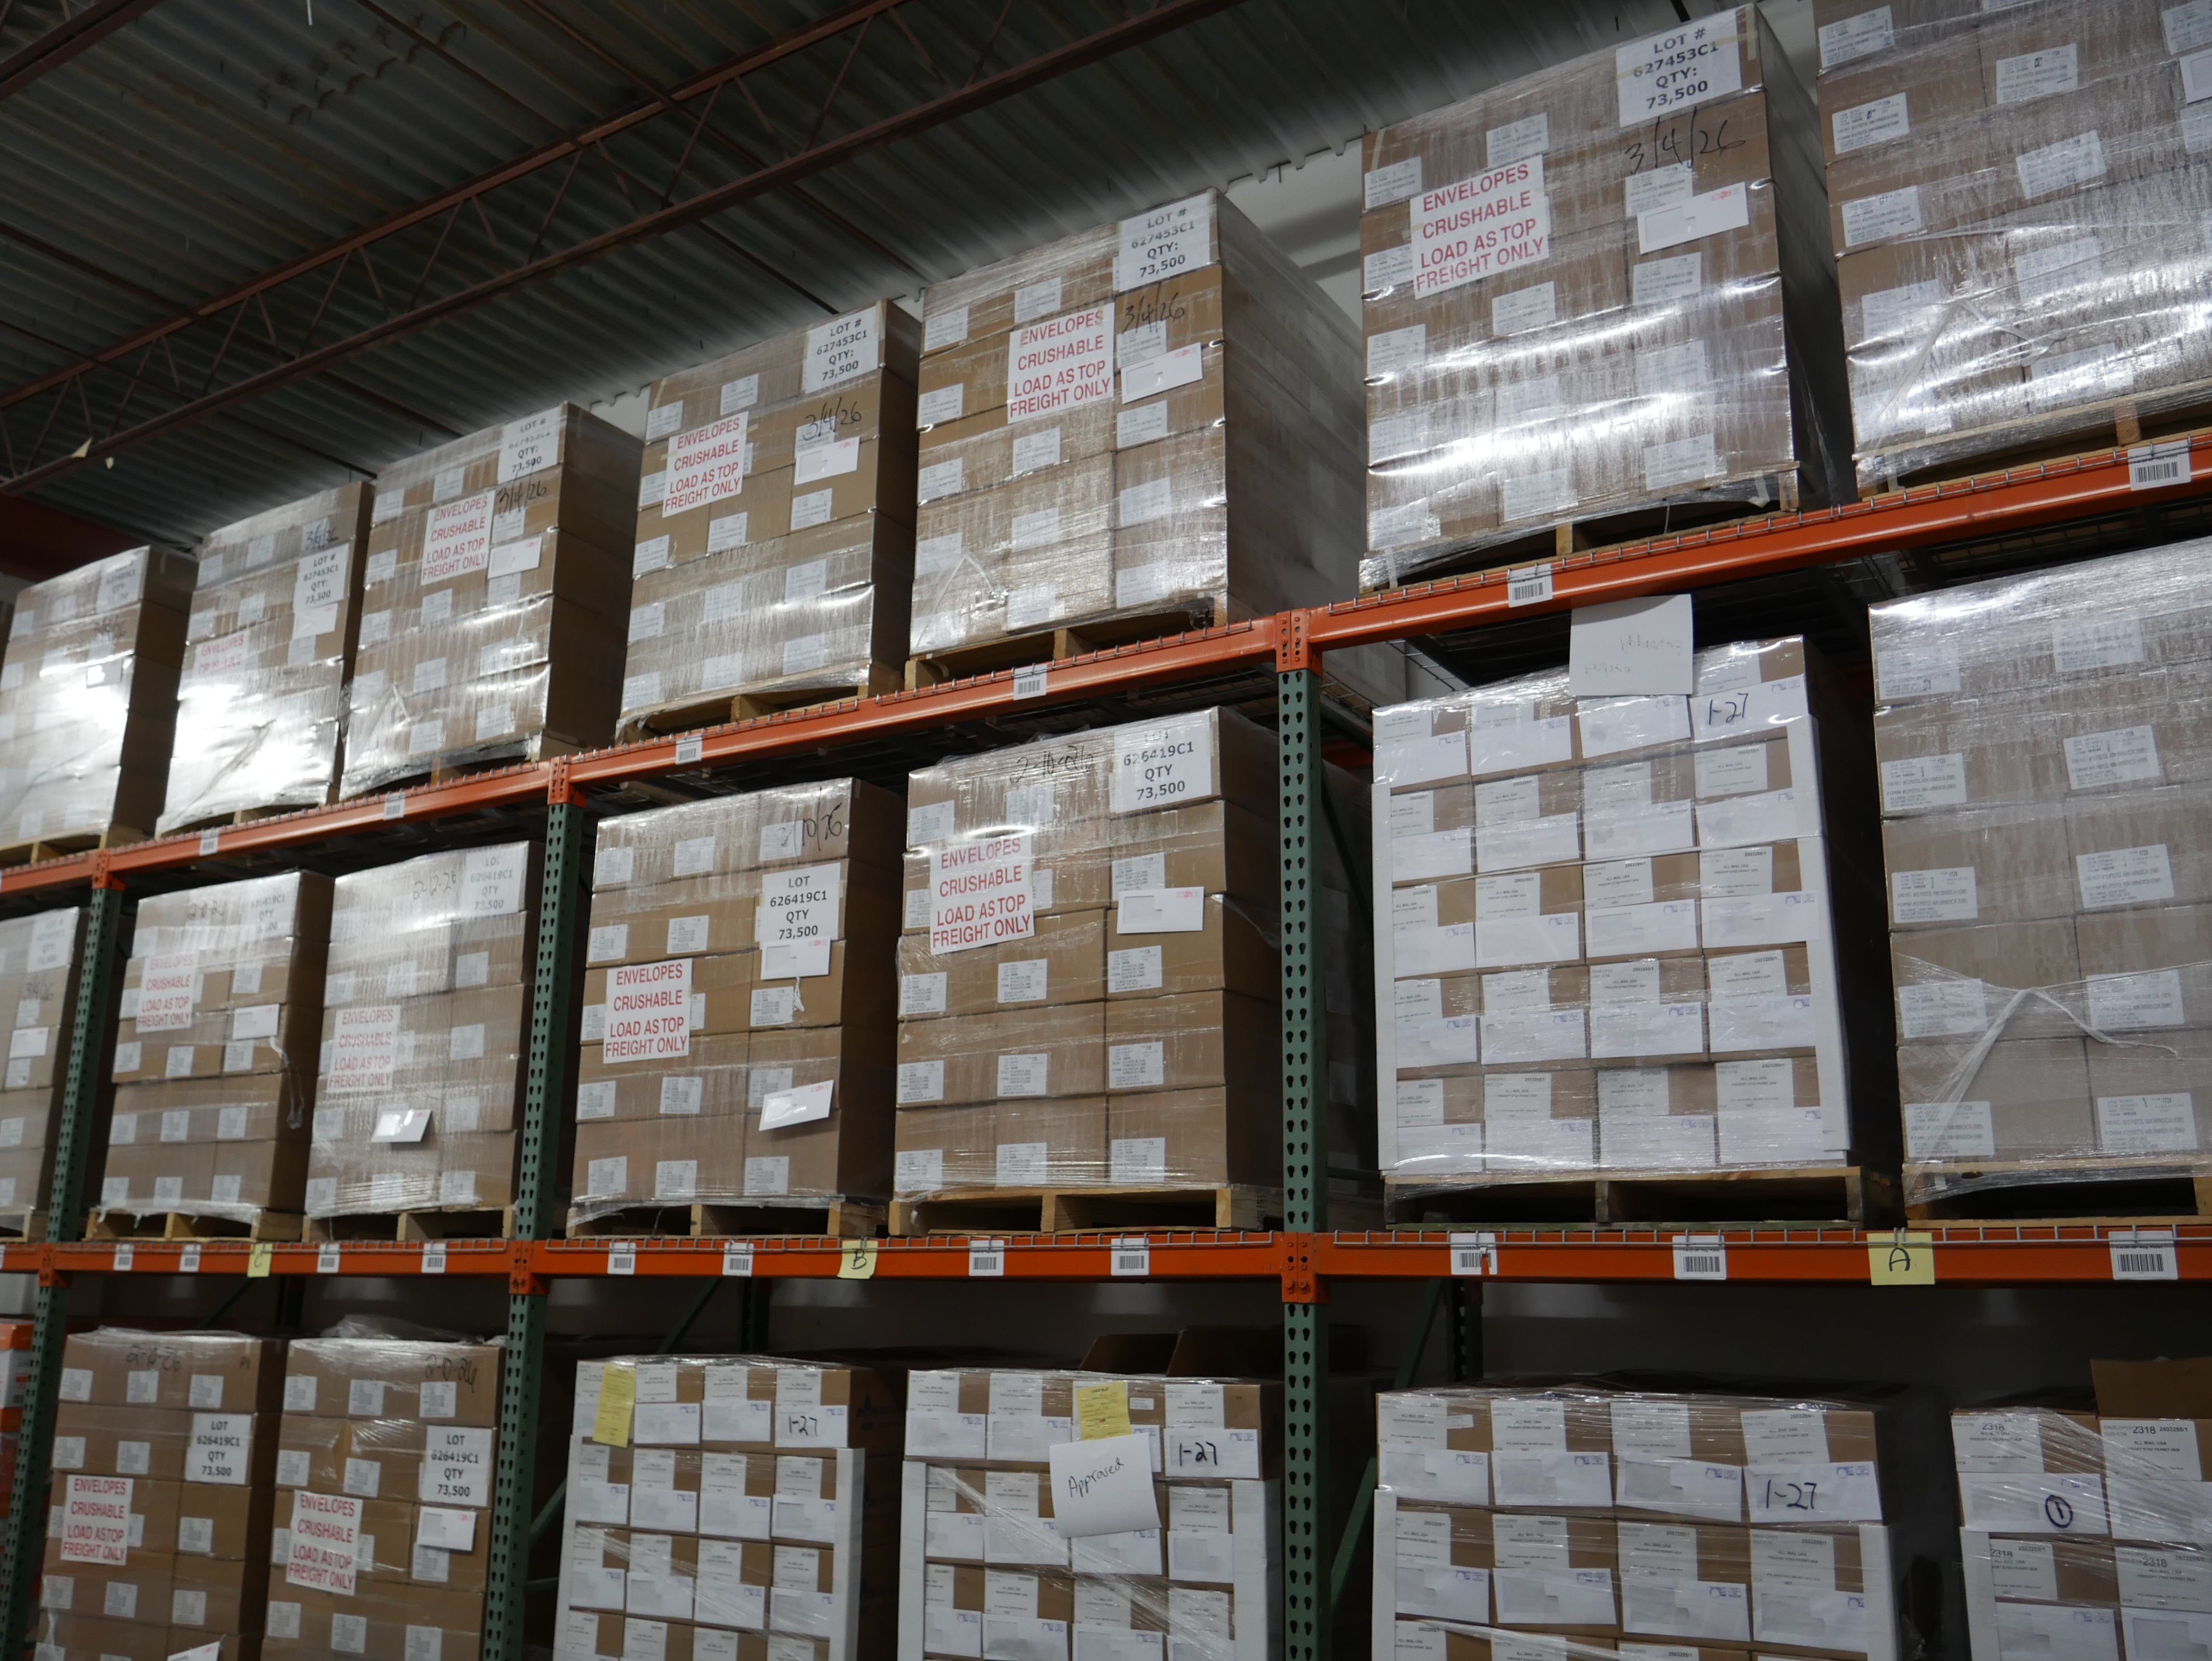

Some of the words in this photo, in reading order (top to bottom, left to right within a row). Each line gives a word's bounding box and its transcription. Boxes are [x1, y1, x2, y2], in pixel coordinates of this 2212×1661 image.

[1654, 34, 1687, 54] LOT
[1694, 27, 1705, 39] #
[1633, 44, 1718, 77] 627453C1
[1656, 67, 1697, 88] QTY:
[1646, 81, 1708, 108] 73,500
[1423, 164, 1529, 212] ENVELOPES
[1148, 212, 1172, 229] LOT
[1177, 207, 1186, 216] #
[1423, 192, 1531, 239] CRUSHABLE
[1147, 242, 1178, 260] QTY:
[1421, 241, 1468, 268] LOAD
[1475, 231, 1497, 252] AS
[1501, 218, 1536, 244] TOP
[1139, 254, 1185, 277] 73,500
[1416, 254, 1491, 292] FREIGHT
[1498, 237, 1542, 266] ONLY
[1121, 282, 1185, 334] 3/4/26
[830, 321, 851, 337] LOT
[855, 318, 861, 327] #
[1020, 311, 1103, 347] ENVELOPES
[817, 330, 867, 355] 627453C1
[1018, 335, 1104, 371] CRUSHABLE
[829, 349, 854, 366] QTY:
[822, 360, 858, 382] 73,500
[1014, 375, 1051, 397] LOAD
[1056, 371, 1074, 386] AS
[1078, 360, 1106, 379] TOP
[1011, 388, 1069, 418] FREIGHT
[1074, 378, 1110, 400] ONLY
[519, 421, 537, 434] LOT
[803, 397, 862, 441] 3/4/26
[678, 417, 739, 449] ENVELOPES
[518, 445, 538, 459] QTY:
[674, 439, 738, 471] CRUSHABLE
[512, 457, 541, 473] 73,500
[670, 474, 698, 494] LOAD
[701, 469, 714, 485] AS
[716, 462, 738, 481] TOP
[665, 487, 710, 512] FREIGHT
[712, 477, 740, 497] ONLY
[434, 496, 487, 520] ENVELOPES
[431, 517, 485, 542] CRUSHABLE
[314, 555, 329, 567] LOT
[427, 546, 450, 564] LOAD
[453, 543, 465, 558] AS
[466, 538, 484, 554] TOP
[423, 560, 461, 580] FREIGHT
[462, 552, 487, 569] ONLY
[311, 580, 327, 592] QTY:
[305, 590, 330, 604] 73,500
[1709, 693, 1748, 725] 1-27
[1146, 765, 1173, 781] QTY
[1137, 781, 1185, 801] 73,500
[941, 838, 1020, 869] ENVELOPES
[482, 885, 499, 897] QTY
[789, 876, 810, 888] LOT
[940, 866, 1021, 896] CRUSHABLE
[770, 891, 827, 907] 626419C1
[786, 910, 809, 923] QTY
[937, 906, 974, 926] LOAD
[979, 900, 995, 918] AS
[998, 895, 1025, 914] TOP
[778, 926, 818, 939] 73,500
[933, 923, 990, 948] FREIGHT
[994, 915, 1030, 935] ONLY
[150, 954, 193, 970] ENVELOPES
[146, 975, 190, 991] CRUSHABLE
[617, 964, 682, 985] ENVELOPES
[142, 1000, 160, 1012] LOAD
[164, 998, 173, 1010] AS
[173, 996, 189, 1007] TOP
[614, 990, 682, 1011] CRUSHABLE
[137, 1015, 169, 1027] FREIGHT
[170, 1012, 191, 1024] ONLY
[342, 1009, 393, 1025] ENVELOPES
[610, 1021, 640, 1037] LOAD
[645, 1019, 659, 1035] AS
[661, 1016, 684, 1033] TOP
[340, 1032, 392, 1048] CRUSHABLE
[606, 1039, 654, 1057] FREIGHT
[657, 1036, 686, 1053] ONLY
[334, 1058, 356, 1070] LOAD
[360, 1057, 371, 1069] AS
[372, 1055, 391, 1068] TOP
[329, 1074, 366, 1088] FREIGHT
[368, 1073, 391, 1086] ONLY
[851, 1249, 867, 1269] B
[1889, 1247, 1911, 1272] A
[211, 1420, 228, 1431] LOT
[788, 1415, 817, 1437] 1-27
[1982, 1422, 2005, 1431] 2318
[2133, 1426, 2157, 1435] 2318
[197, 1435, 239, 1447] 626419C1
[447, 1435, 465, 1446] LOT
[208, 1450, 225, 1463] QTY
[1179, 1441, 1217, 1466] 1-27
[202, 1465, 231, 1477] 73,500
[444, 1467, 464, 1481] QTY
[1069, 1457, 1125, 1498] Approved
[75, 1478, 126, 1495] ENVELOPES
[437, 1484, 470, 1498] 73,500
[1766, 1479, 1817, 1510] 1-27
[71, 1502, 124, 1519] CRUSHABLE
[300, 1493, 355, 1517] ENVELOPES
[67, 1524, 92, 1539] LOAD
[94, 1527, 107, 1540] AS
[107, 1528, 124, 1542] TOP
[297, 1518, 352, 1543] CRUSHABLE
[64, 1542, 101, 1556] FREIGHT
[103, 1546, 126, 1560] ONLY
[293, 1543, 318, 1562] LOAD
[320, 1550, 333, 1566] AS
[334, 1552, 352, 1569] TOP
[1990, 1549, 2014, 1557] 2318
[2143, 1557, 2167, 1567] 2318
[289, 1562, 328, 1582] FREIGHT
[329, 1570, 354, 1589] ONLY
